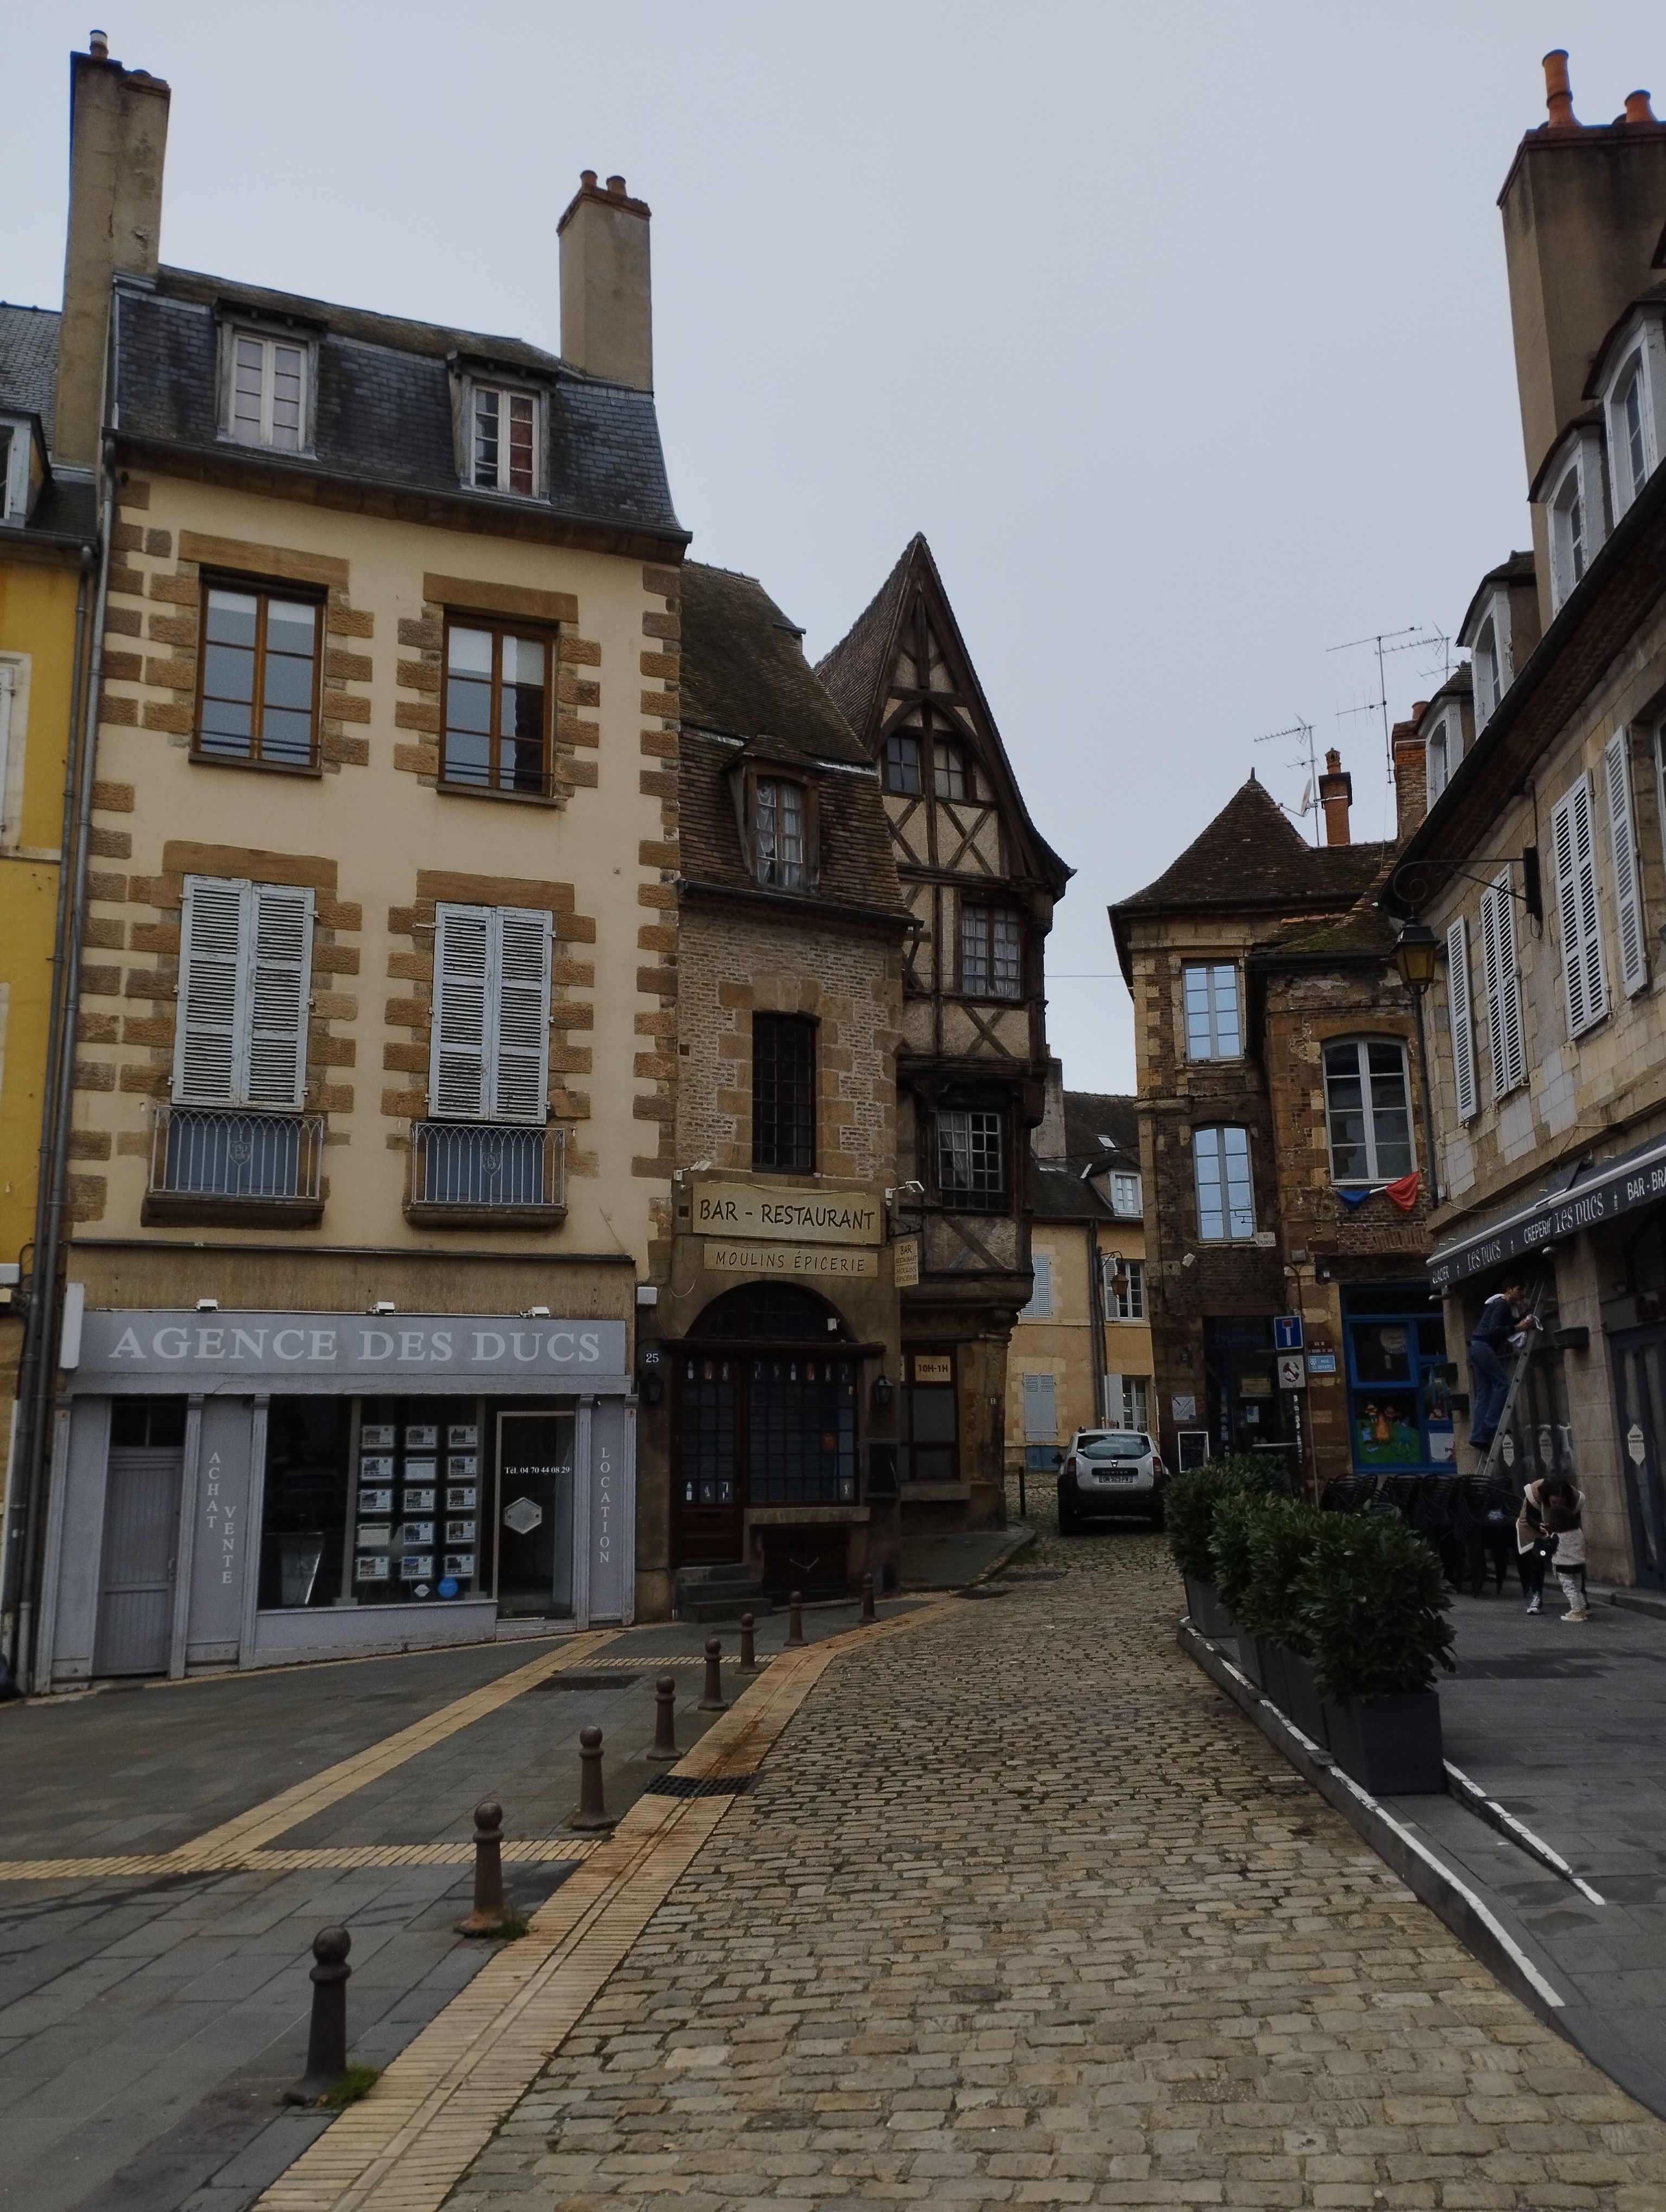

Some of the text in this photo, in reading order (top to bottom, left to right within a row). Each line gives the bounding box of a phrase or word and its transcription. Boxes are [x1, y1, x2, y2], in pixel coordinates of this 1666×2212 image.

[1627, 1177, 1645, 1201] BAR
[700, 1199, 738, 1222] BAR
[761, 1204, 875, 1231] RESTAURANT
[900, 1245, 912, 1255] BAR
[716, 1251, 865, 1272] MOULINS ÉPICERIE
[896, 1265, 917, 1275] MOULINS
[1432, 1265, 1450, 1285] GLACIER
[108, 1327, 600, 1362] AGENCE DES DUCS
[645, 1353, 659, 1364] 25
[918, 1364, 949, 1373] 10H-1H
[520, 1466, 529, 1475] 04
[530, 1466, 540, 1475] 70
[541, 1466, 550, 1474] 44
[551, 1465, 560, 1474] 08
[561, 1465, 570, 1474] 29
[206, 1452, 221, 1529] ACHAT
[599, 1447, 610, 1563] LOCATION
[221, 1506, 236, 1585] VENTE
